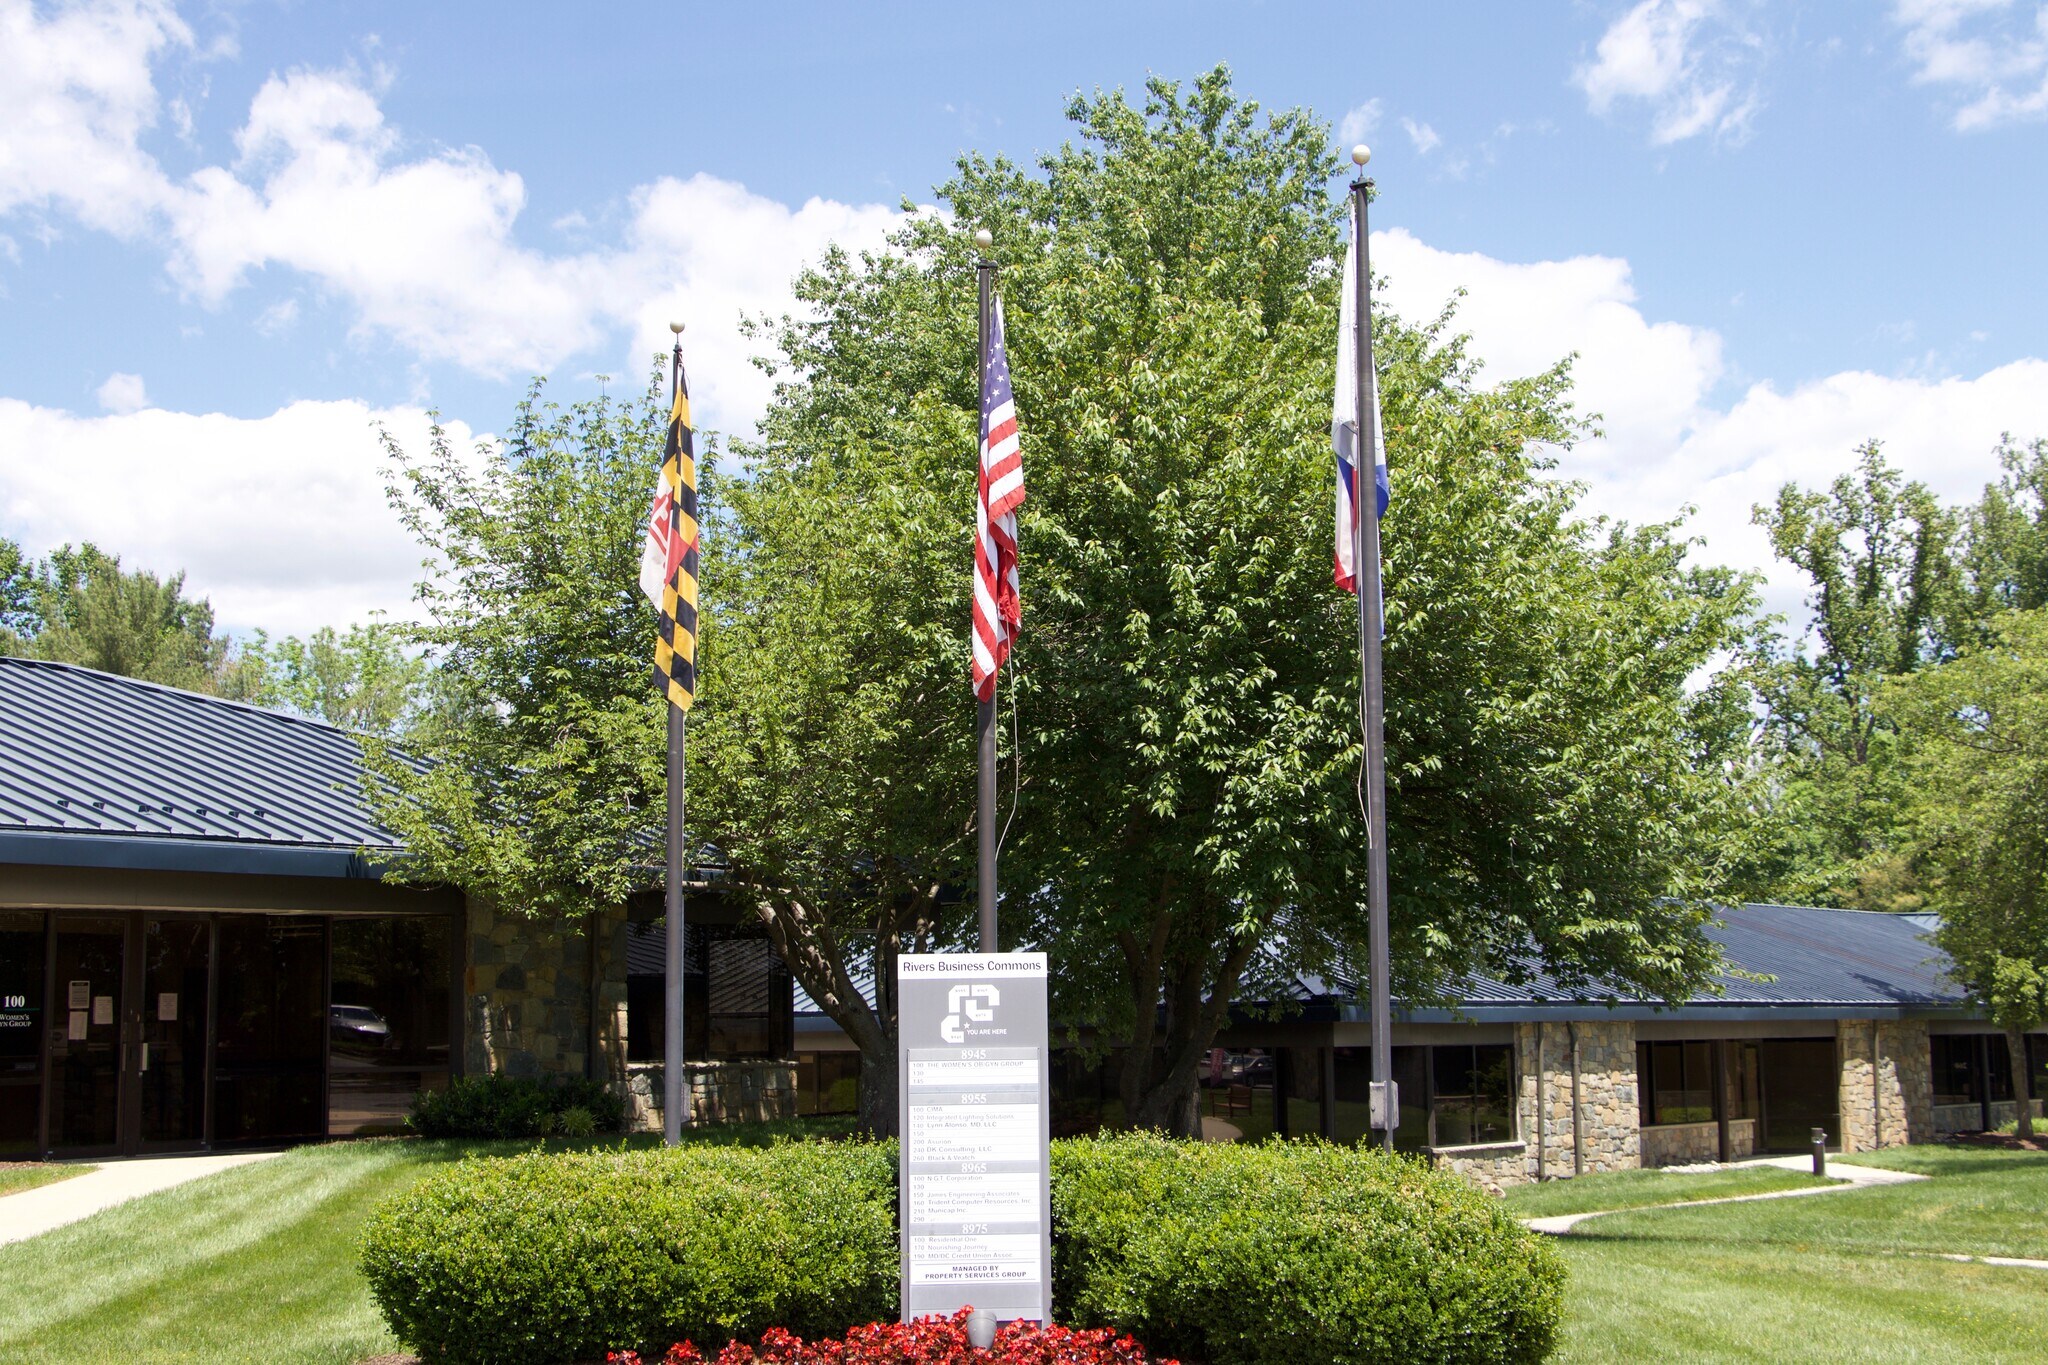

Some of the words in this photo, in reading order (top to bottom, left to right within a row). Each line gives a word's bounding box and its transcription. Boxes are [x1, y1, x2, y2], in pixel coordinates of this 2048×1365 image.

[903, 961, 935, 972] Rivers
[938, 961, 985, 971] Business
[987, 960, 1042, 971] Commons
[5, 995, 26, 1008] 100
[961, 1049, 987, 1060] 8945
[961, 1094, 987, 1104] 8955
[961, 1163, 987, 1173] 8965
[962, 1224, 988, 1234] 8975
